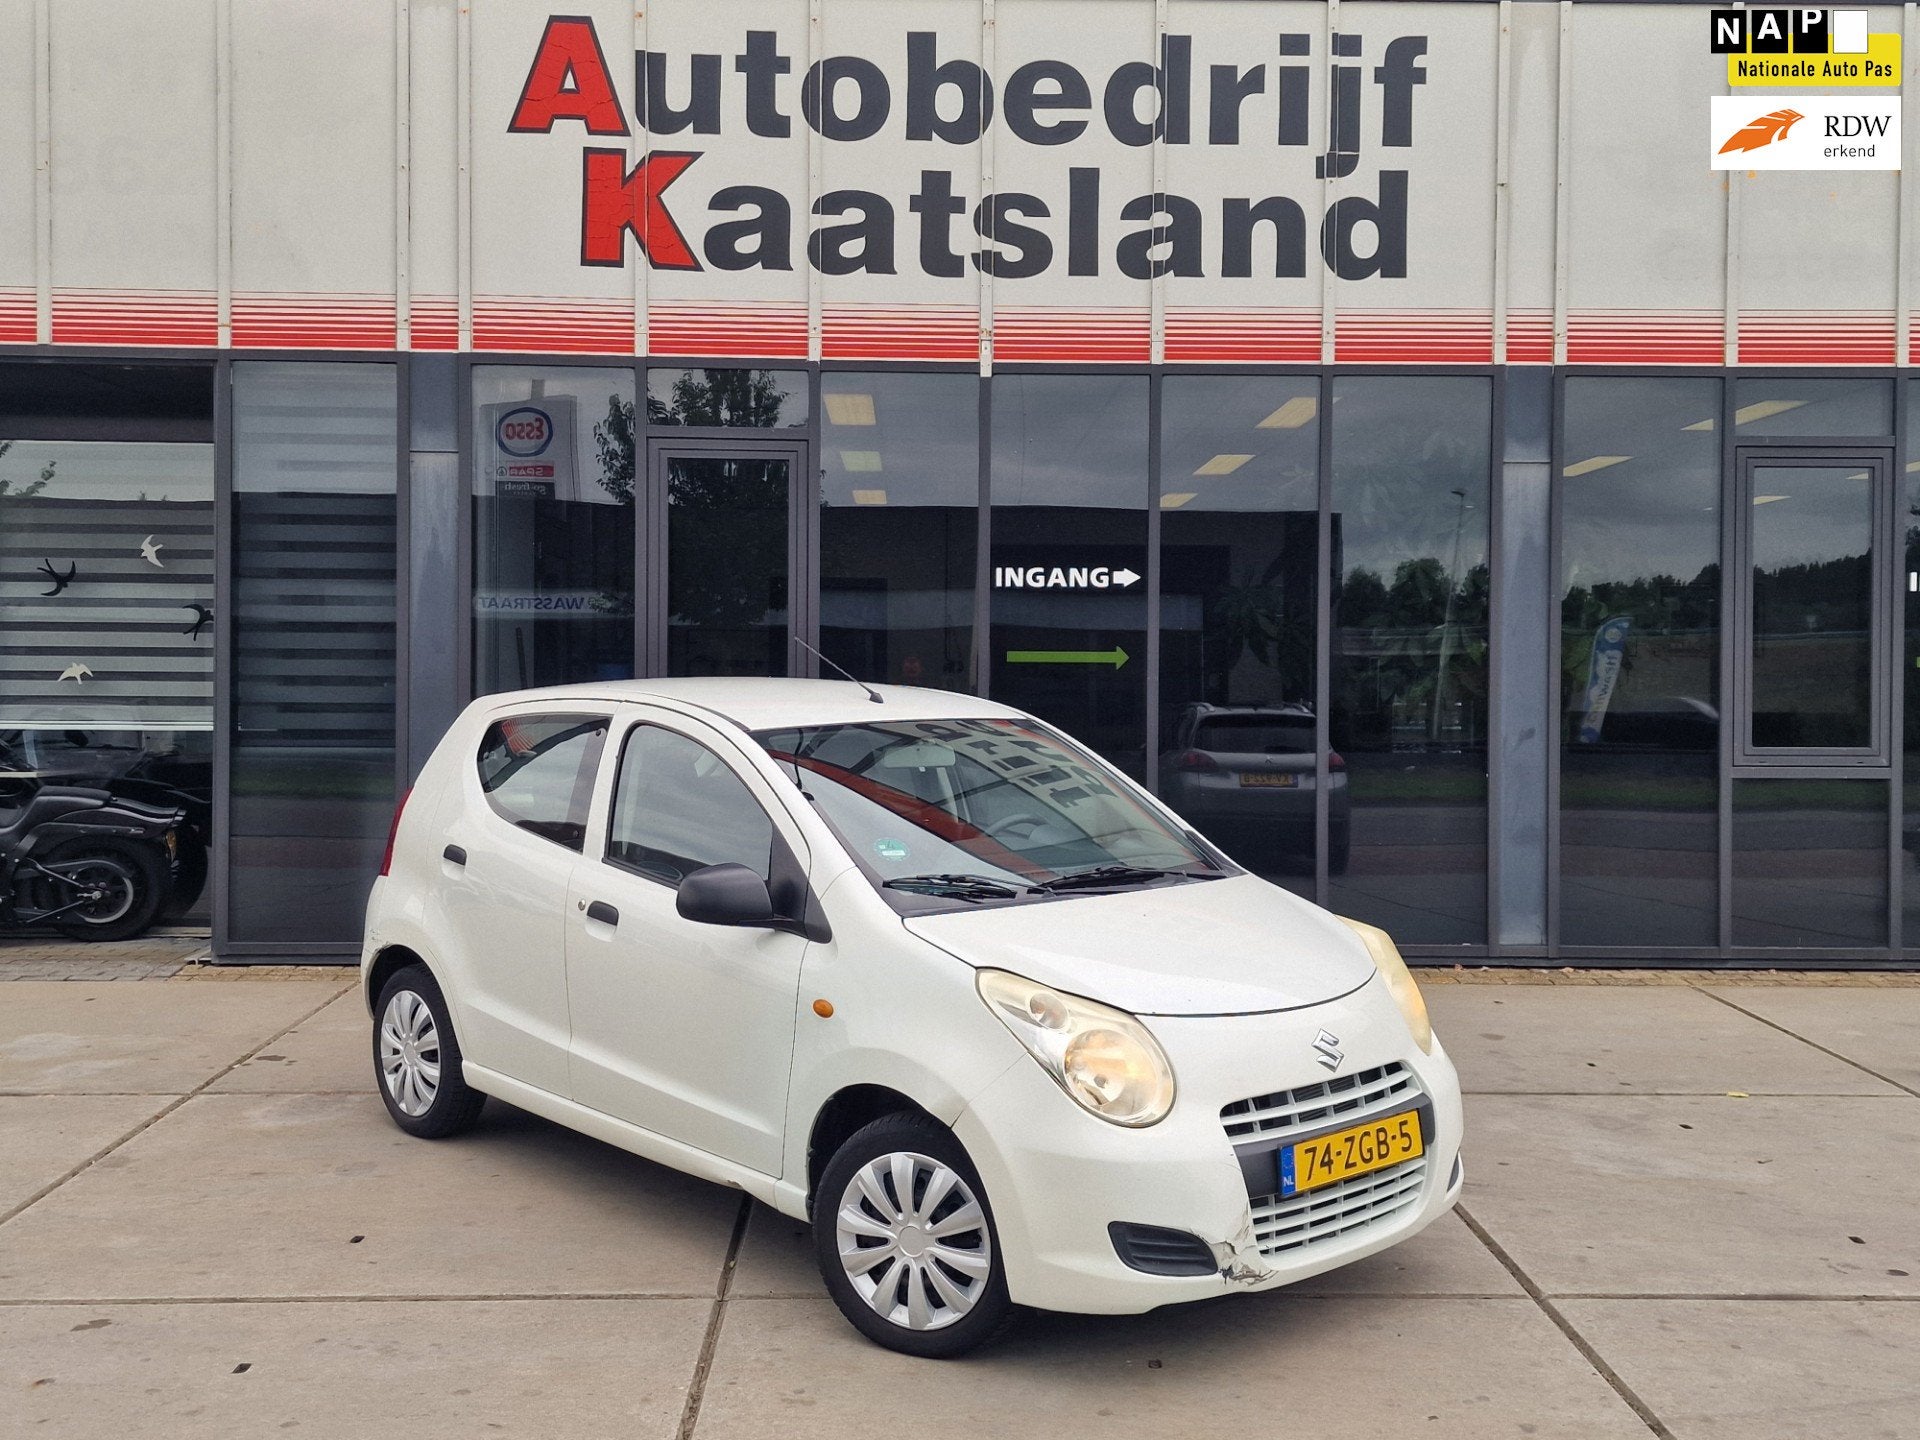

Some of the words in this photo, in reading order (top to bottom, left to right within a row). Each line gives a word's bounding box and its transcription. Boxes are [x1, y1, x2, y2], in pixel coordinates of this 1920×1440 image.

[506, 14, 1428, 179] Autobedrijf
[580, 147, 1408, 280] Kaatsland
[995, 567, 1110, 588] INGANG
[1283, 1176, 1294, 1186] NL
[1304, 1119, 1413, 1181] 74-ZGB-5
